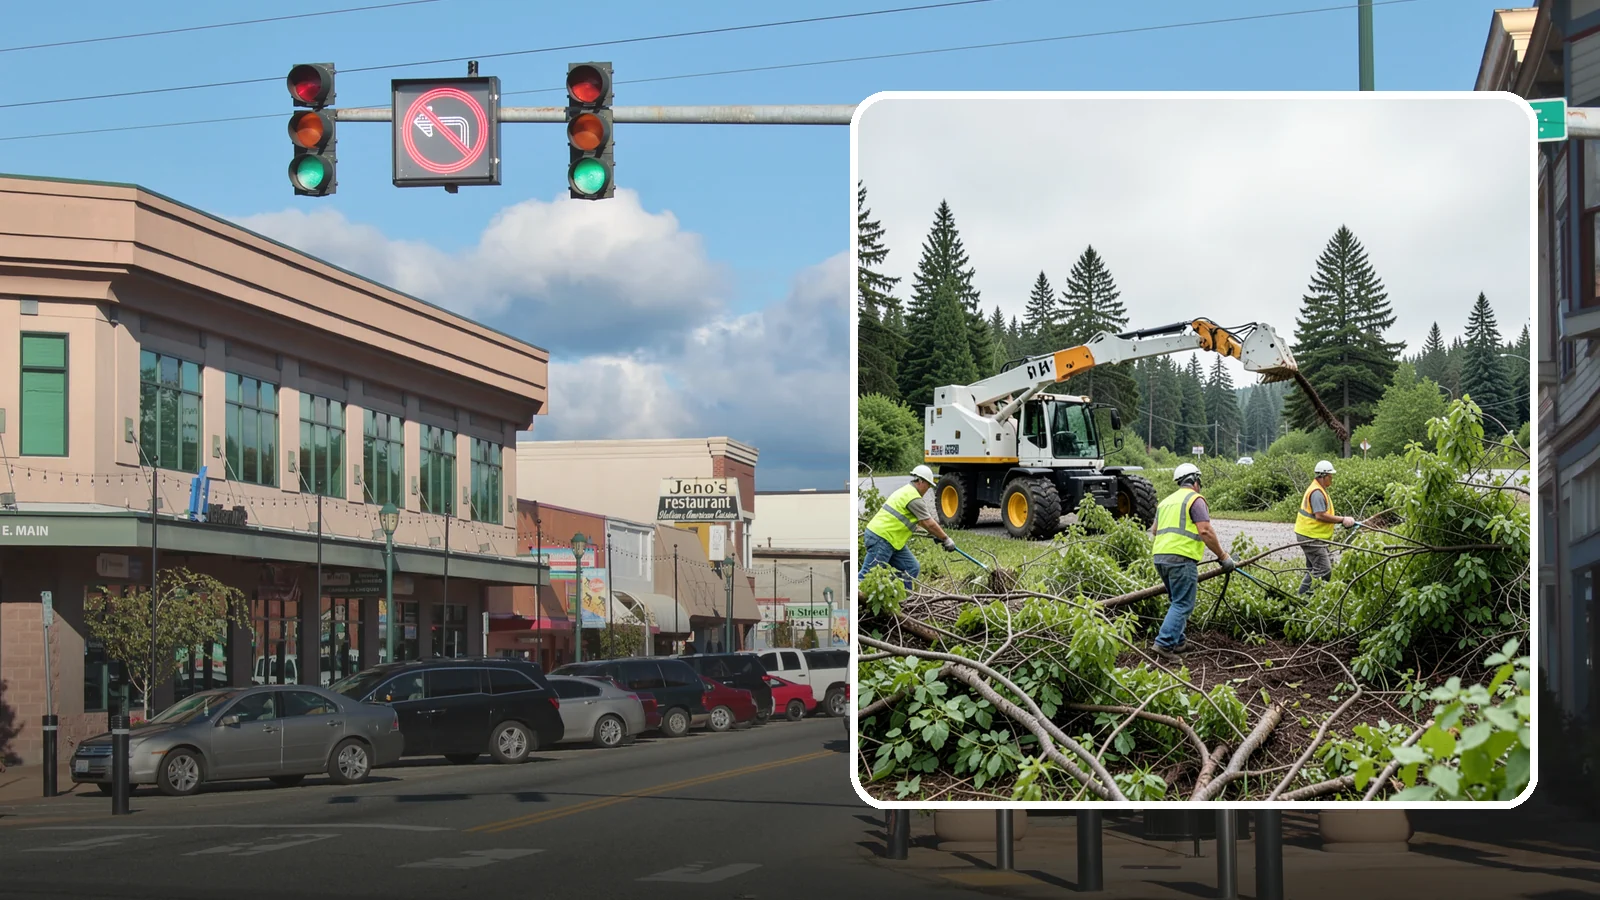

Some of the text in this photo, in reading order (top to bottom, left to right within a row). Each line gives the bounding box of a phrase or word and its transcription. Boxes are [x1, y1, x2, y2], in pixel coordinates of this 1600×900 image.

[670, 480, 727, 495] Jeno's
[665, 496, 731, 509] restaurant
[686, 509, 714, 520] American
[715, 509, 738, 520] Cuisine
[2, 525, 49, 536] E. MAIN
[797, 607, 828, 617] Street
